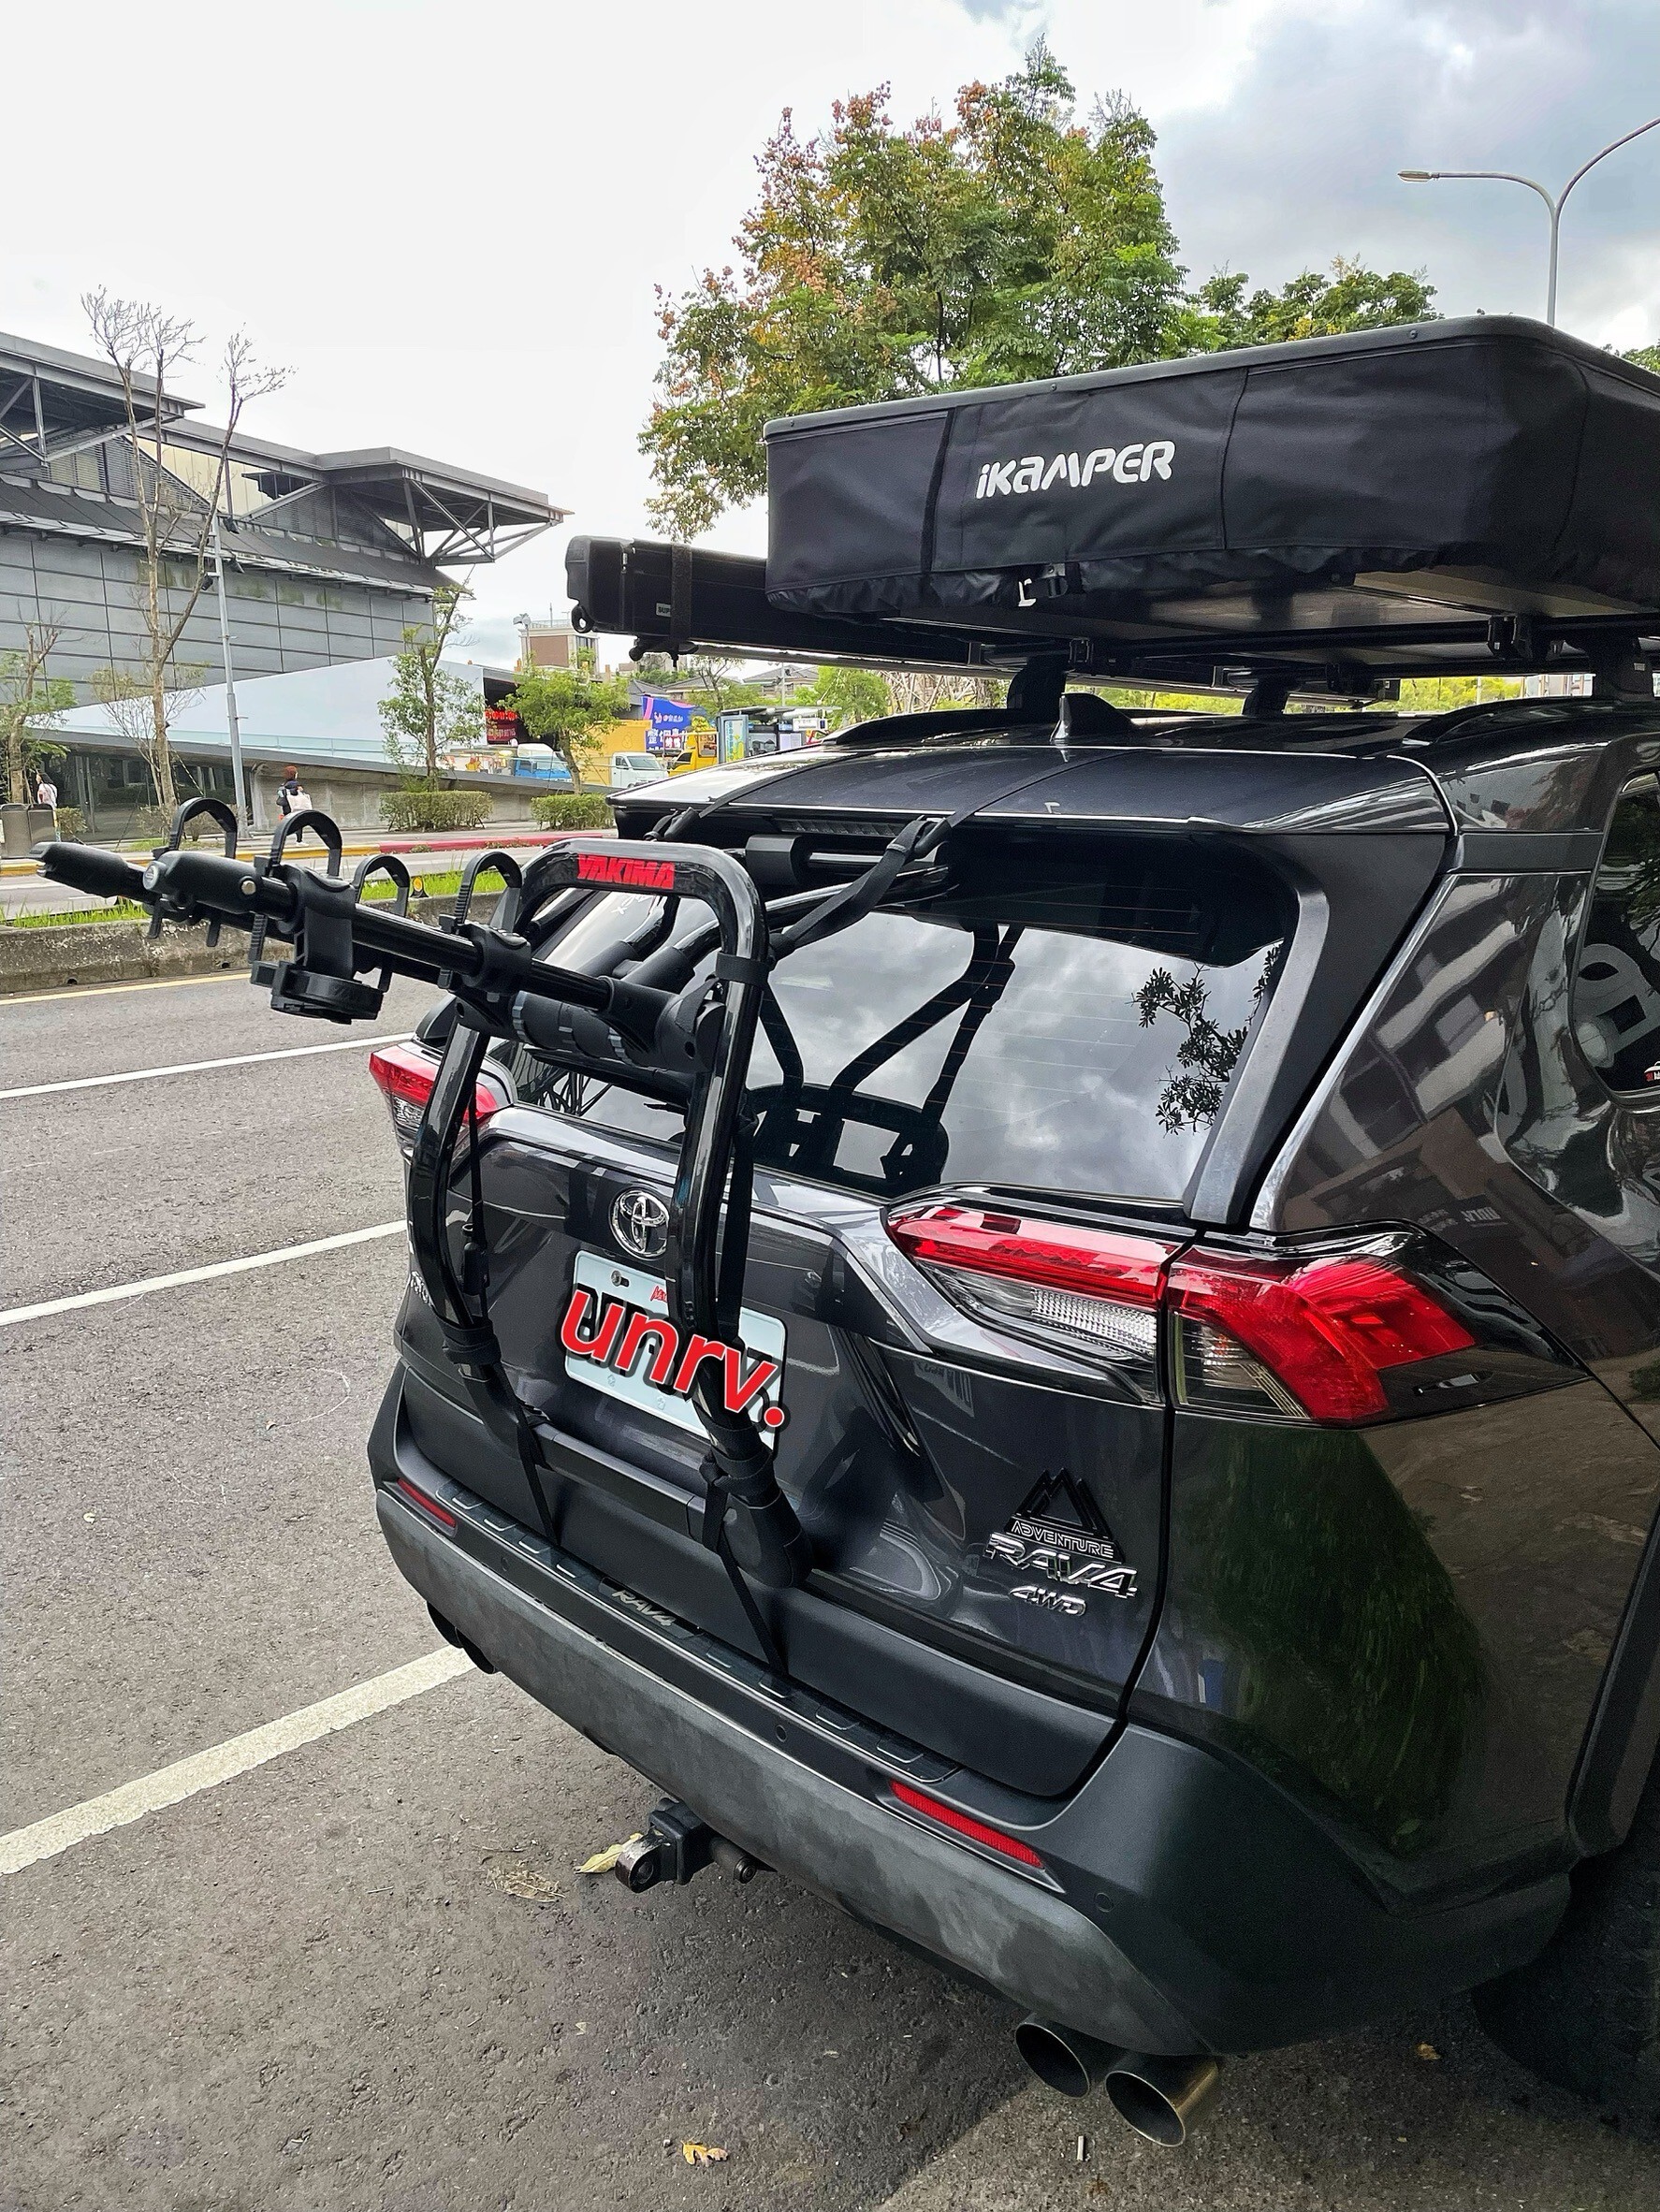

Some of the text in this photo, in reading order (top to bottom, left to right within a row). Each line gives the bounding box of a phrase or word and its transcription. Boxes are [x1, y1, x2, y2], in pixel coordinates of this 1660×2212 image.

[577, 853, 675, 890] YAKIMA
[1011, 1519, 1114, 1559] ADVENTURE
[983, 1532, 1139, 1599] RAV4
[610, 1589, 677, 1627] RAV4
[1009, 1584, 1087, 1617] 4WD
